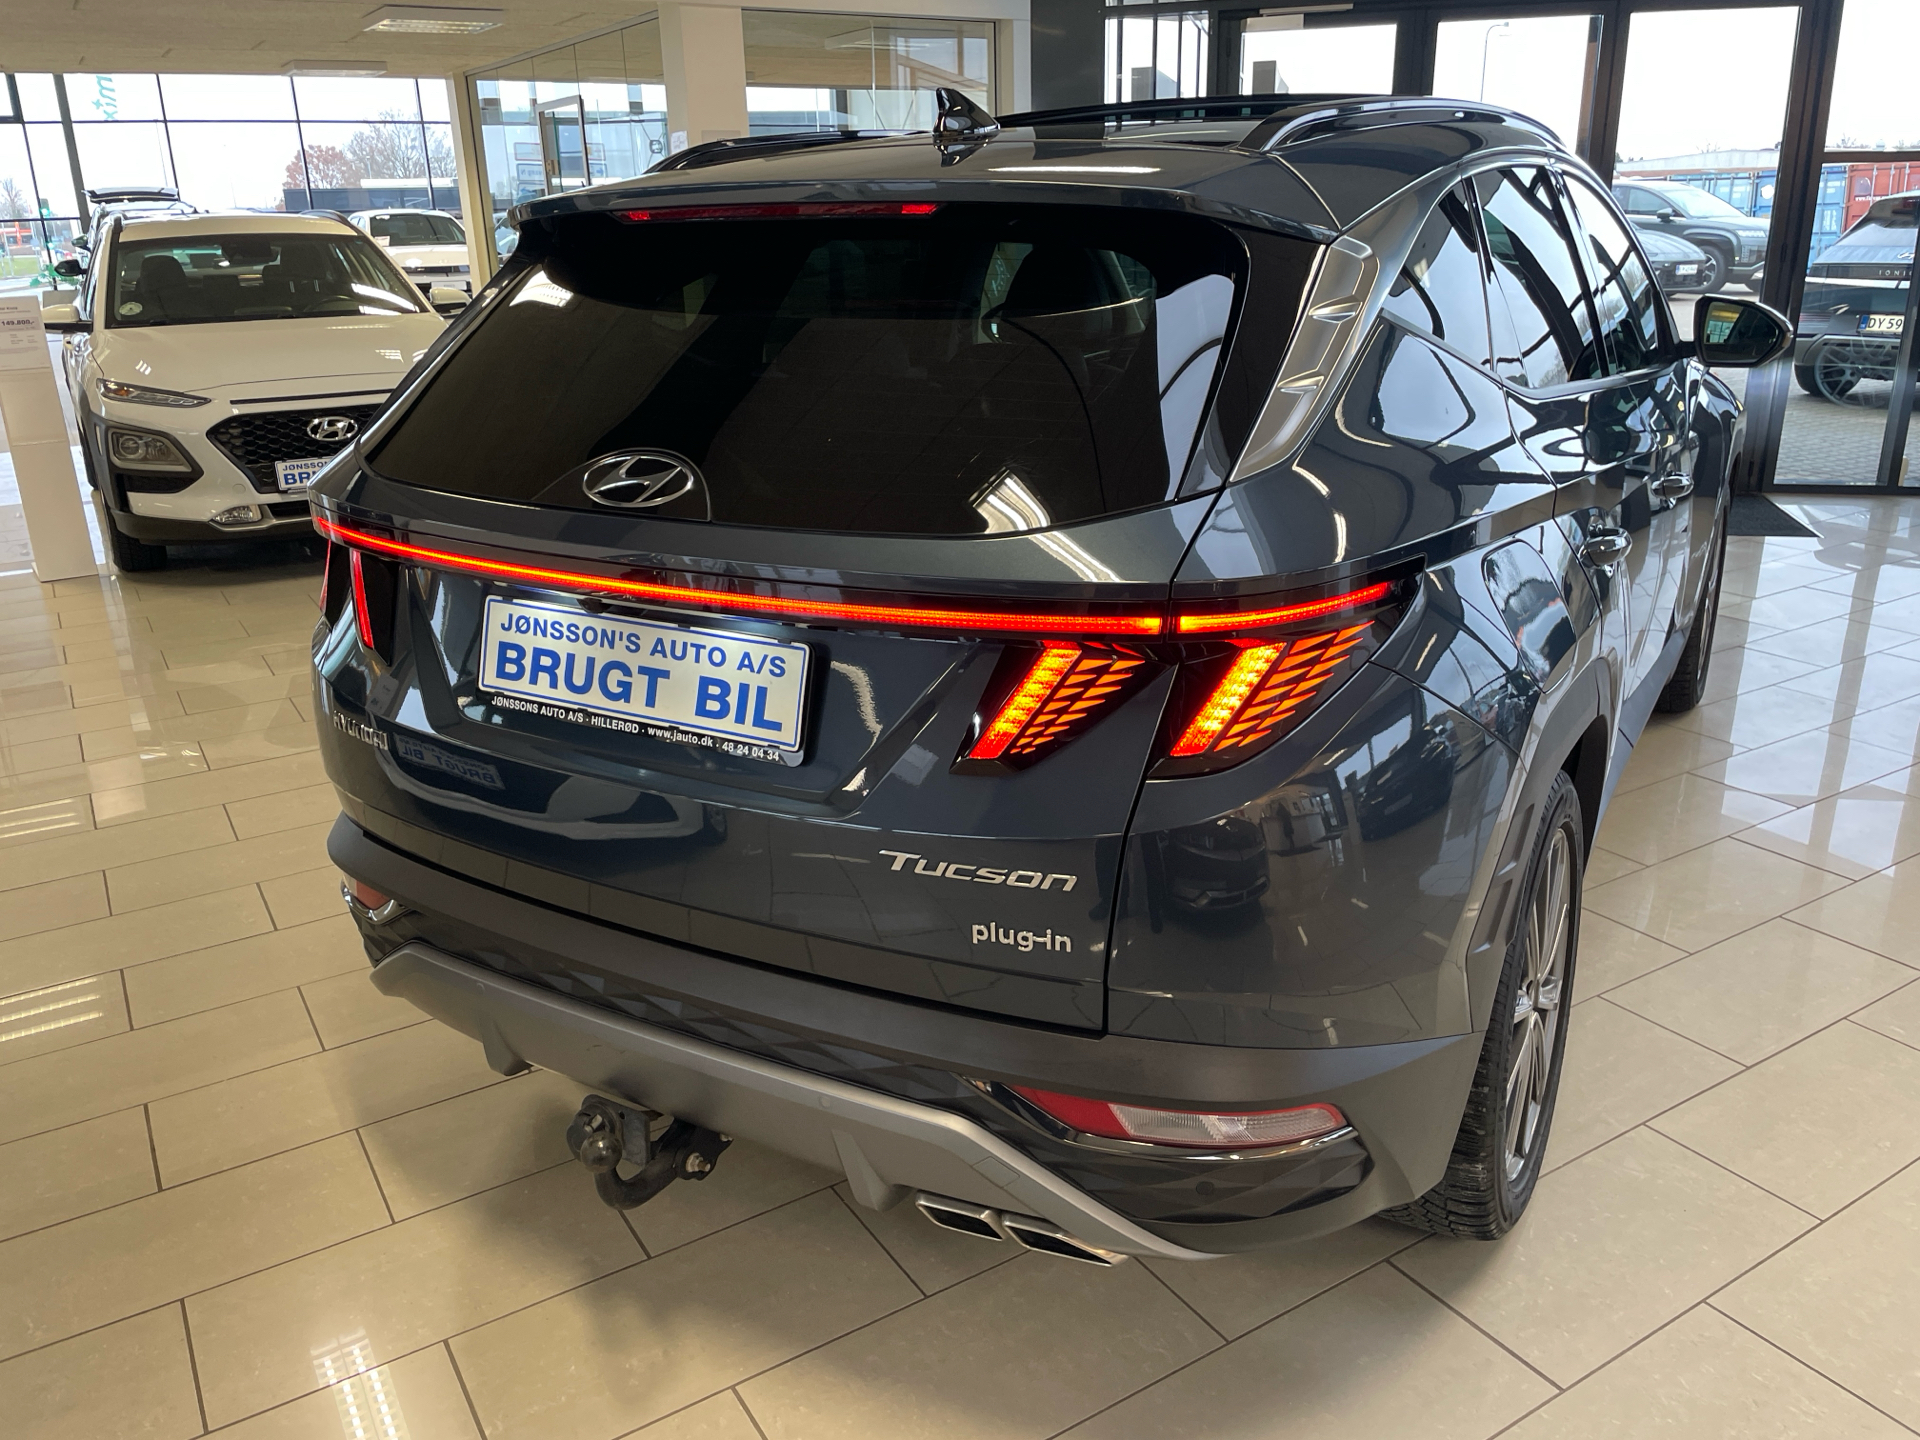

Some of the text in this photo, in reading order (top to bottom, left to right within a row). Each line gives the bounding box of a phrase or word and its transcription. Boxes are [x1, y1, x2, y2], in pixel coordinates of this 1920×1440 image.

[1867, 317, 1903, 330] DY 59
[500, 612, 787, 678] JØNSSON'S AUTO A/S
[495, 640, 783, 732] BRUGT BIL
[491, 695, 780, 762] JØNSSONS AUTO A/S HILLERØD www.jauto.dk 48 24 04 34
[971, 921, 1072, 953] plug-in
